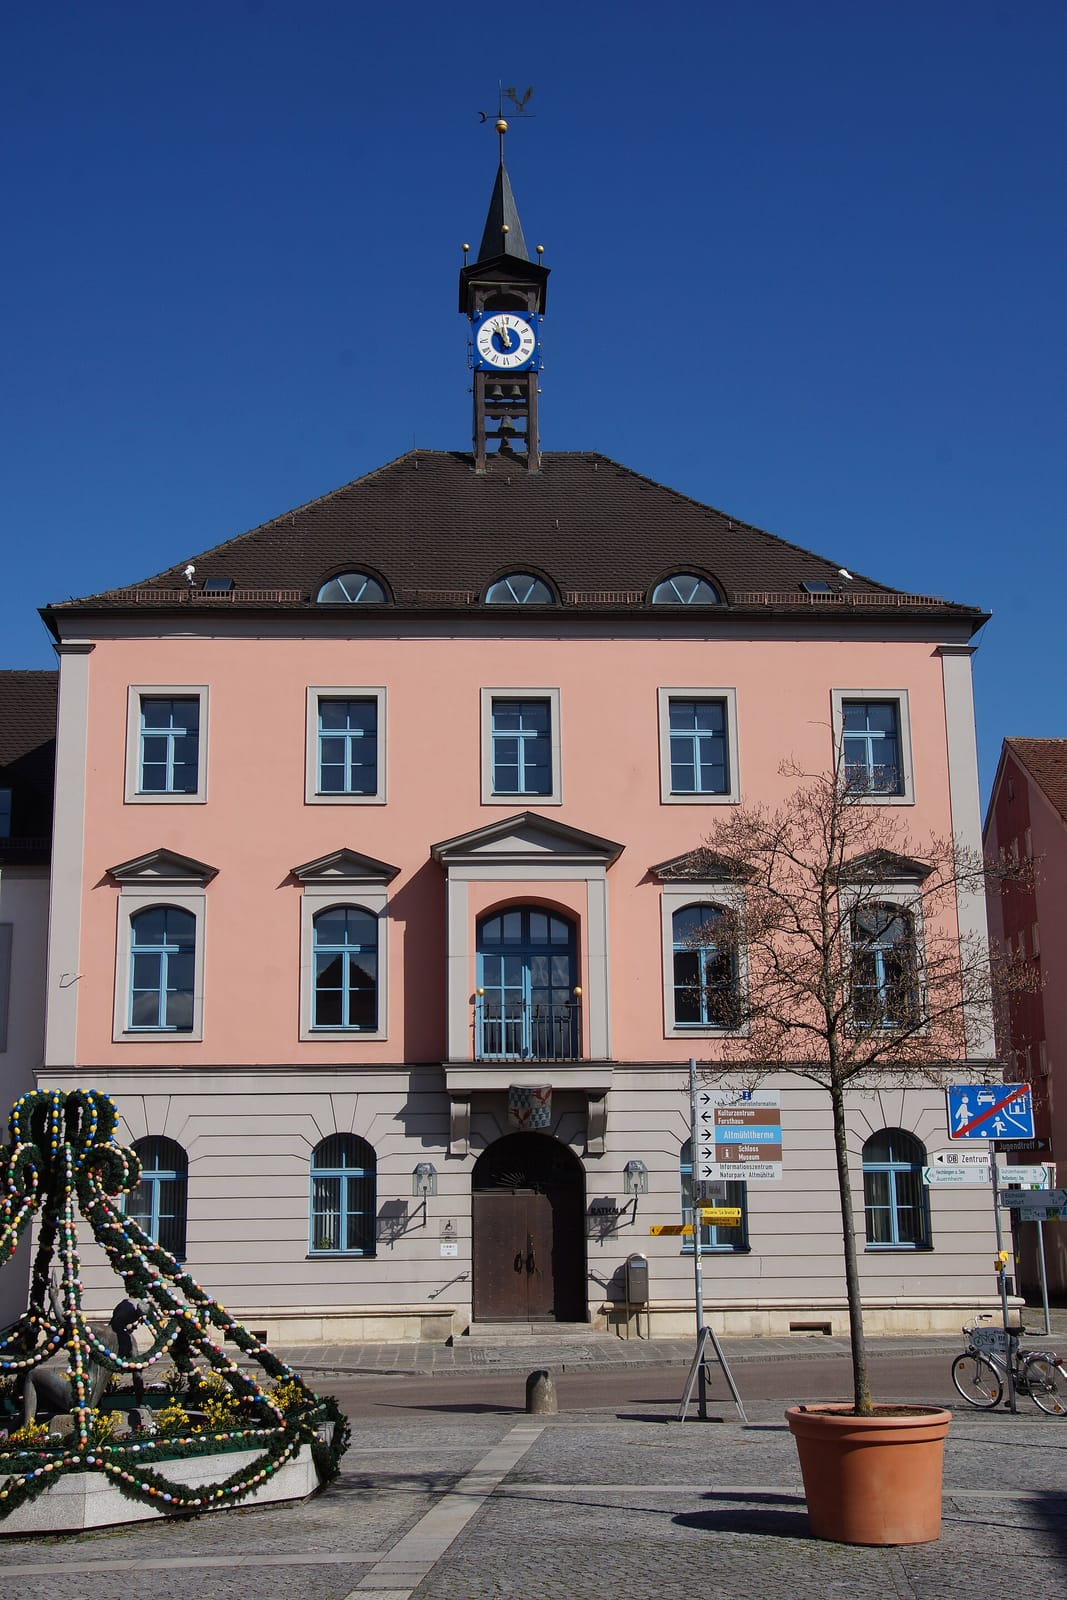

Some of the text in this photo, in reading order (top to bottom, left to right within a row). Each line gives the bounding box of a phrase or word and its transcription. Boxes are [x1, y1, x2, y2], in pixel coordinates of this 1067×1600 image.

[723, 1131, 774, 1139] Altmühltherme
[738, 1145, 759, 1153] Schloss
[1000, 1141, 1035, 1151] Jugendtreff
[961, 1155, 988, 1163] Zentrum
